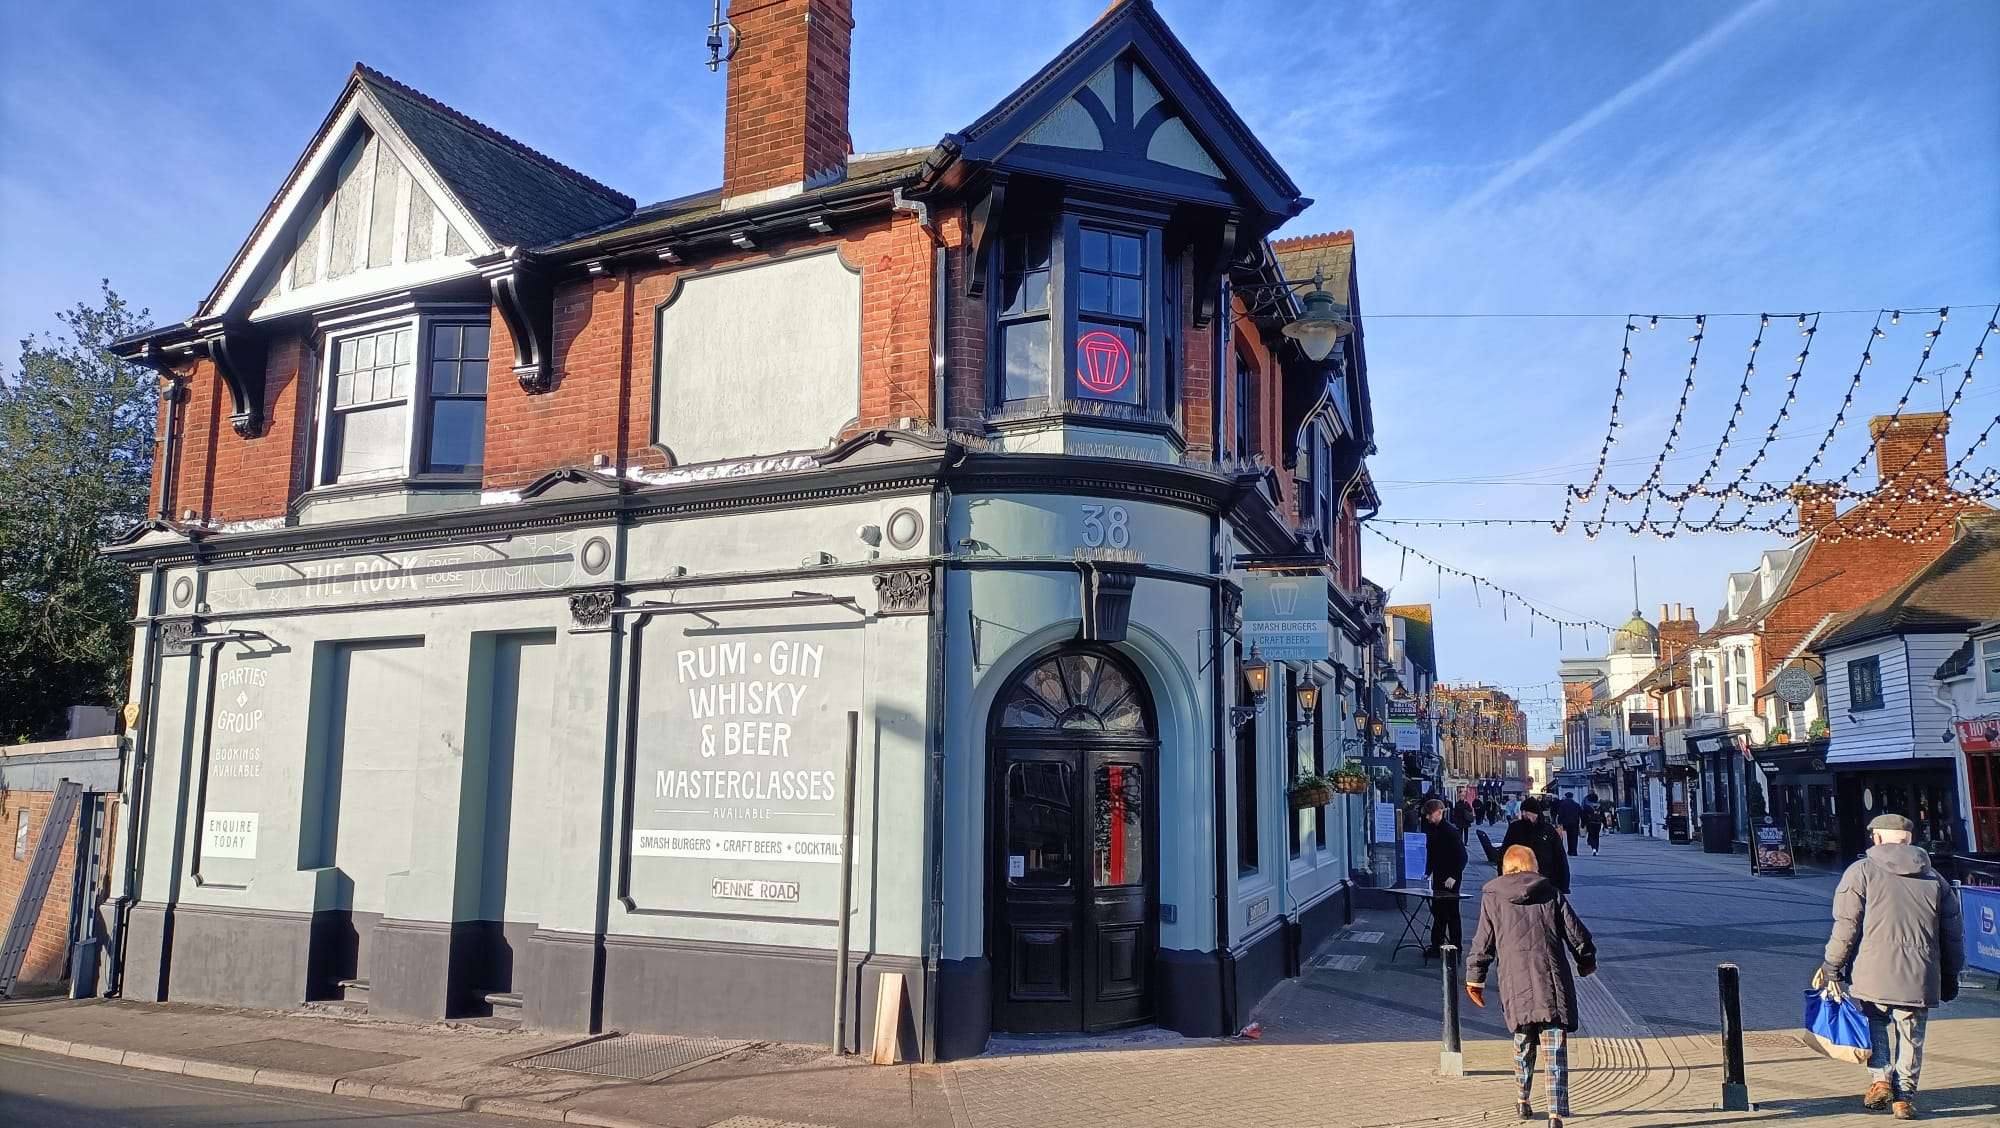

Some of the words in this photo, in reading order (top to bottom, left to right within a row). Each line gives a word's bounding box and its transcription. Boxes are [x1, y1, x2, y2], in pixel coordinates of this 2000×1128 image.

[1081, 504, 1129, 549] 38
[303, 562, 345, 598] THE
[353, 555, 419, 594] ROCK
[426, 571, 464, 584] HOUSE
[1252, 622, 1280, 632] SMASH
[1281, 622, 1318, 632] BURGERS
[1260, 635, 1285, 645] CRAFT
[1285, 635, 1311, 645] BEERS
[677, 641, 747, 684] RUM
[769, 640, 825, 679] GIN
[1264, 647, 1306, 658] COCKTAILS
[220, 666, 268, 690] PARTIES
[688, 680, 809, 720] WHISKY
[217, 709, 263, 734] GROUP
[701, 723, 717, 758] &
[724, 721, 792, 759] BEER
[215, 747, 261, 761] BOOKINGS
[213, 764, 261, 777] AVAILABLE
[655, 770, 836, 802] MASTERCLASSES
[712, 807, 772, 820] AVAILABLE
[209, 819, 252, 833] ENQUIRE
[213, 835, 246, 849] TODAY
[639, 836, 670, 850] SMASH
[671, 838, 711, 852] BURGERS
[723, 840, 753, 853] CRAFT
[754, 841, 782, 854] BEERS
[794, 842, 844, 856] COCKTAILS
[714, 880, 754, 897] DENNE
[760, 883, 796, 899] ROAD
